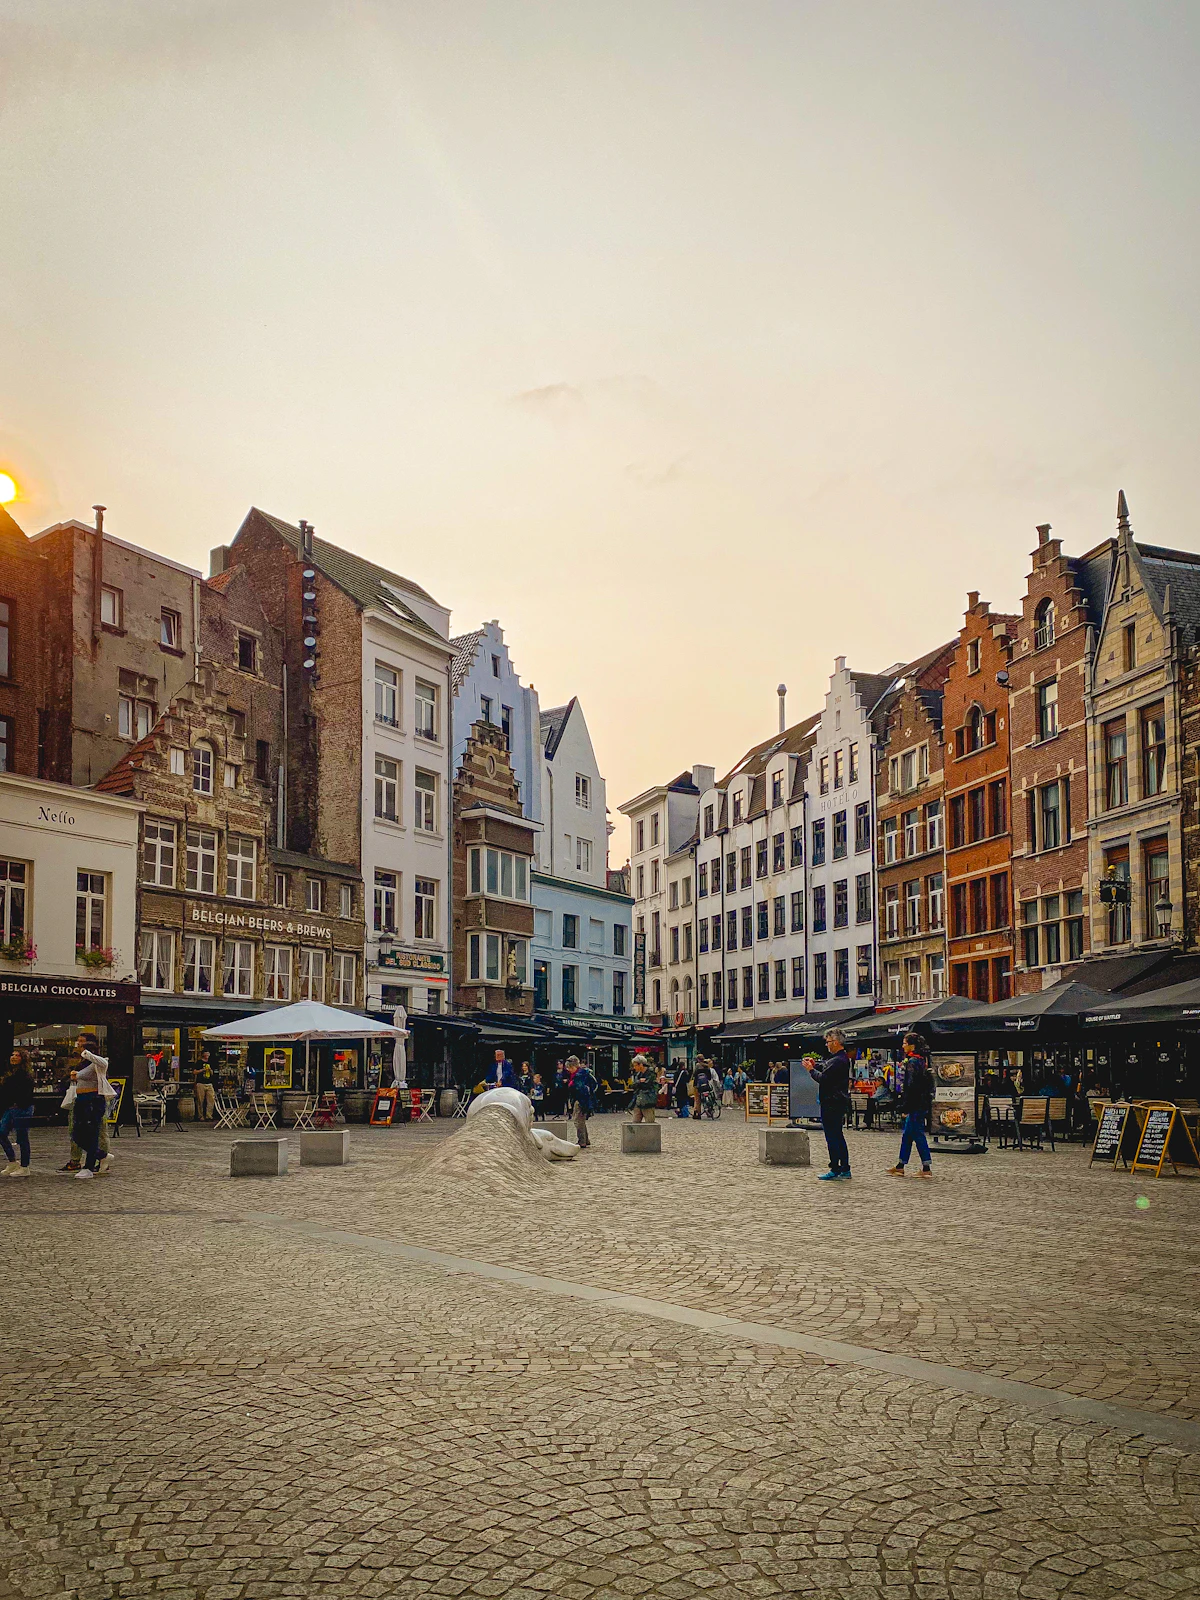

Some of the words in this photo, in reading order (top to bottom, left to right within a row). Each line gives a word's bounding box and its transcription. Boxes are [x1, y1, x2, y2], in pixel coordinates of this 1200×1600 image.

[38, 806, 75, 825] Nello
[192, 909, 245, 926] BELGIAN
[248, 917, 283, 932] BEERS
[286, 922, 294, 933] &
[296, 924, 332, 939] BREWS
[1, 983, 48, 994] BELGIAN
[51, 985, 117, 998] CHOCOLATES
